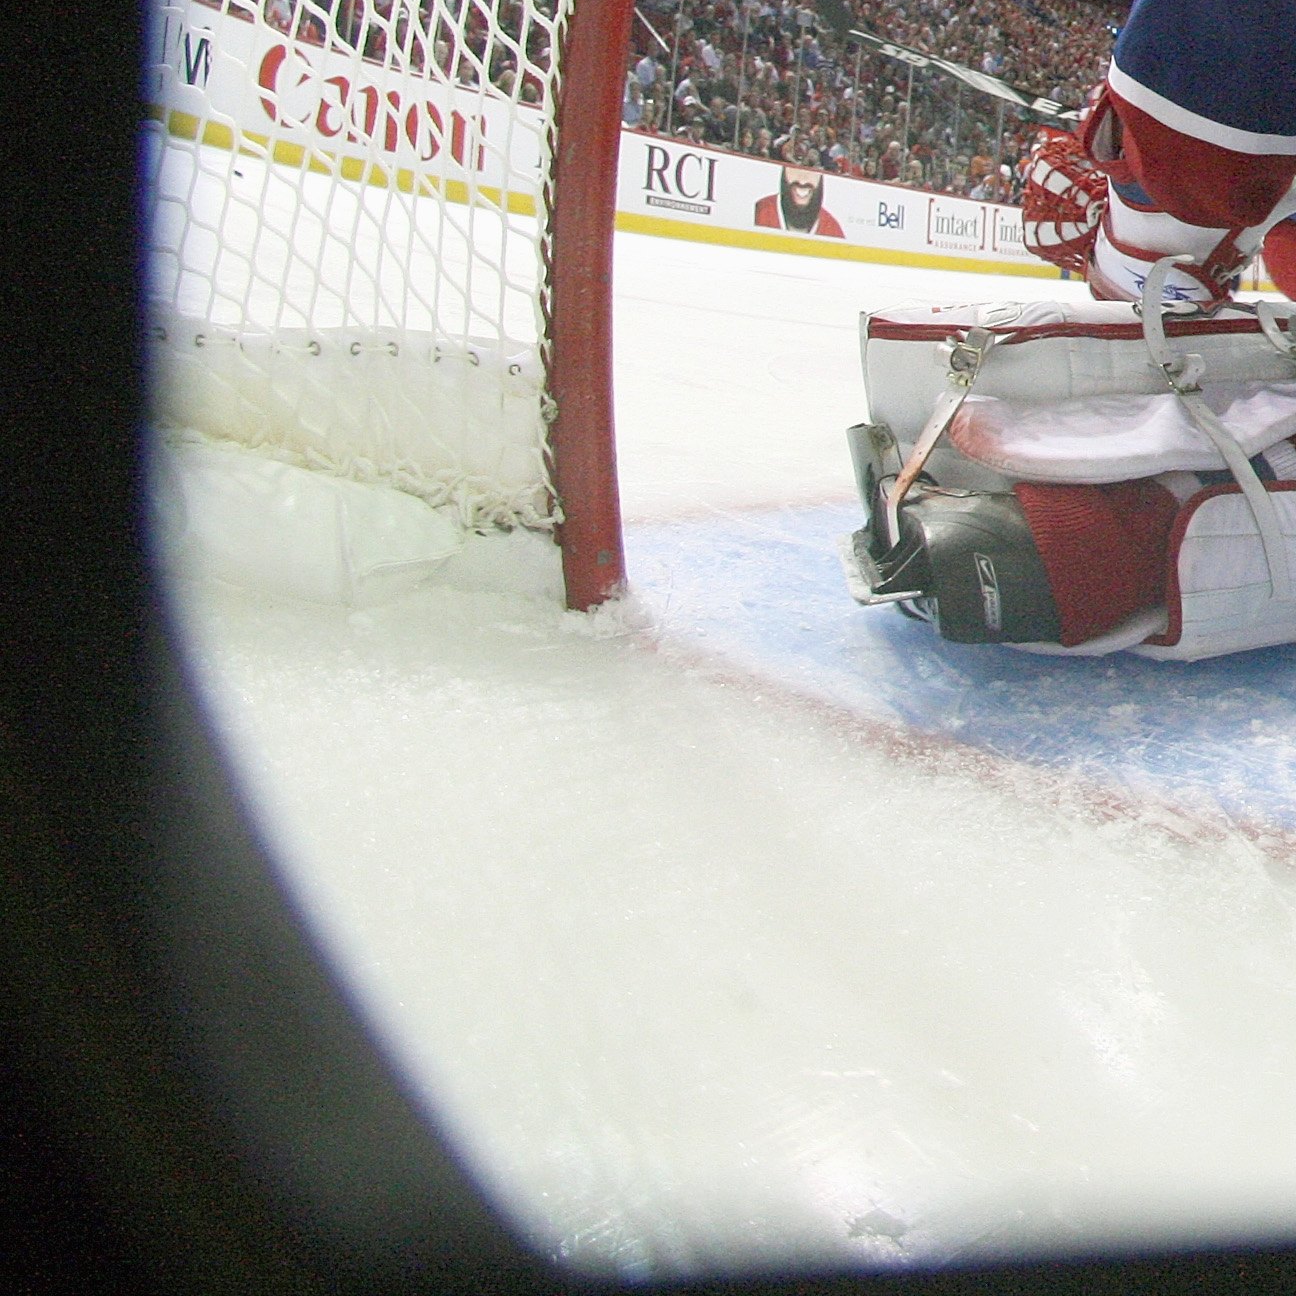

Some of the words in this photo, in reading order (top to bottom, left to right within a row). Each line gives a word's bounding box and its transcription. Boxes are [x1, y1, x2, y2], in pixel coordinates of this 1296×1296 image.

[258, 44, 487, 172] Canon
[642, 144, 719, 202] RCI
[878, 202, 904, 230] Bell
